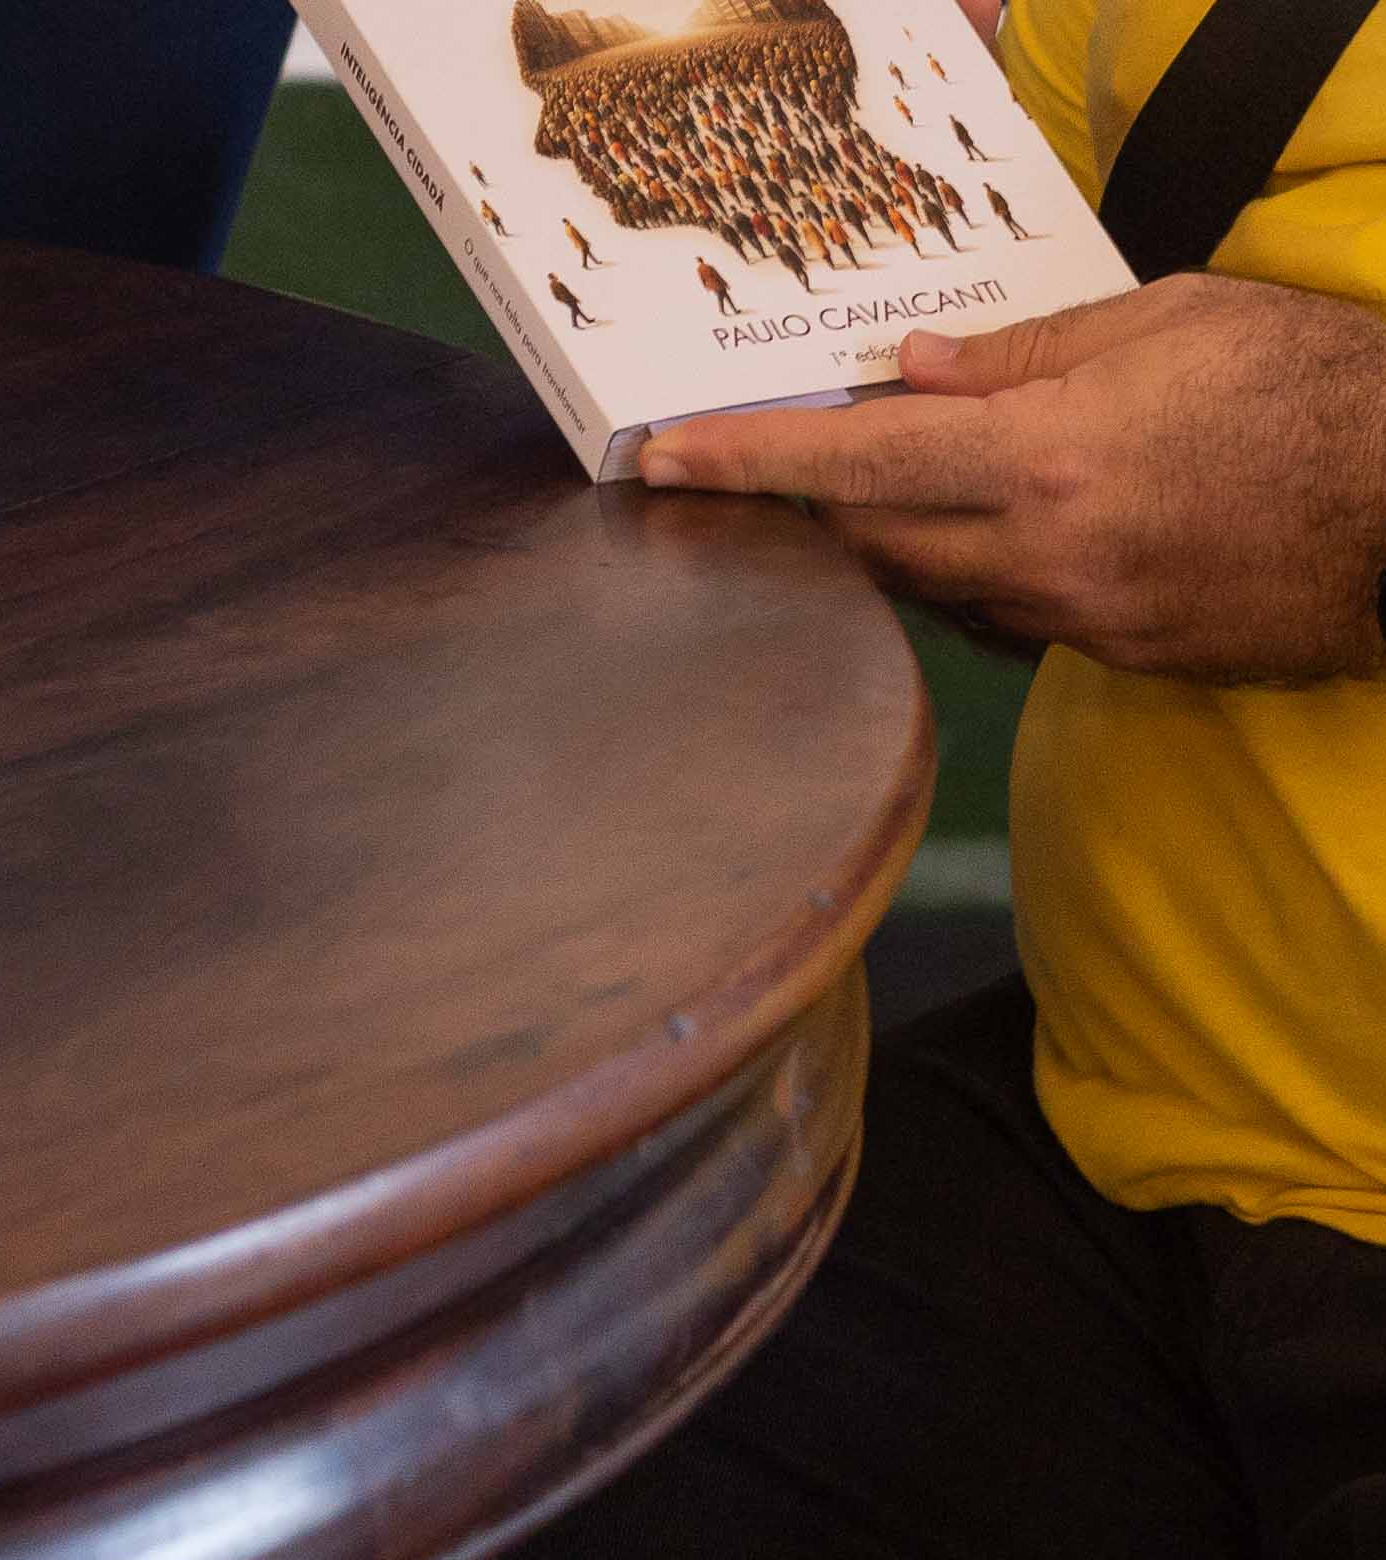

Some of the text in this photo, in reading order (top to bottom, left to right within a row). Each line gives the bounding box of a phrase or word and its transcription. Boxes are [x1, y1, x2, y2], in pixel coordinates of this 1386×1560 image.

[340, 41, 446, 213] INTELIGÊNCIA CIDADÃ
[464, 238, 586, 435] O que nos falta para transformar
[712, 279, 1008, 351] PAULO CAVALCANTI
